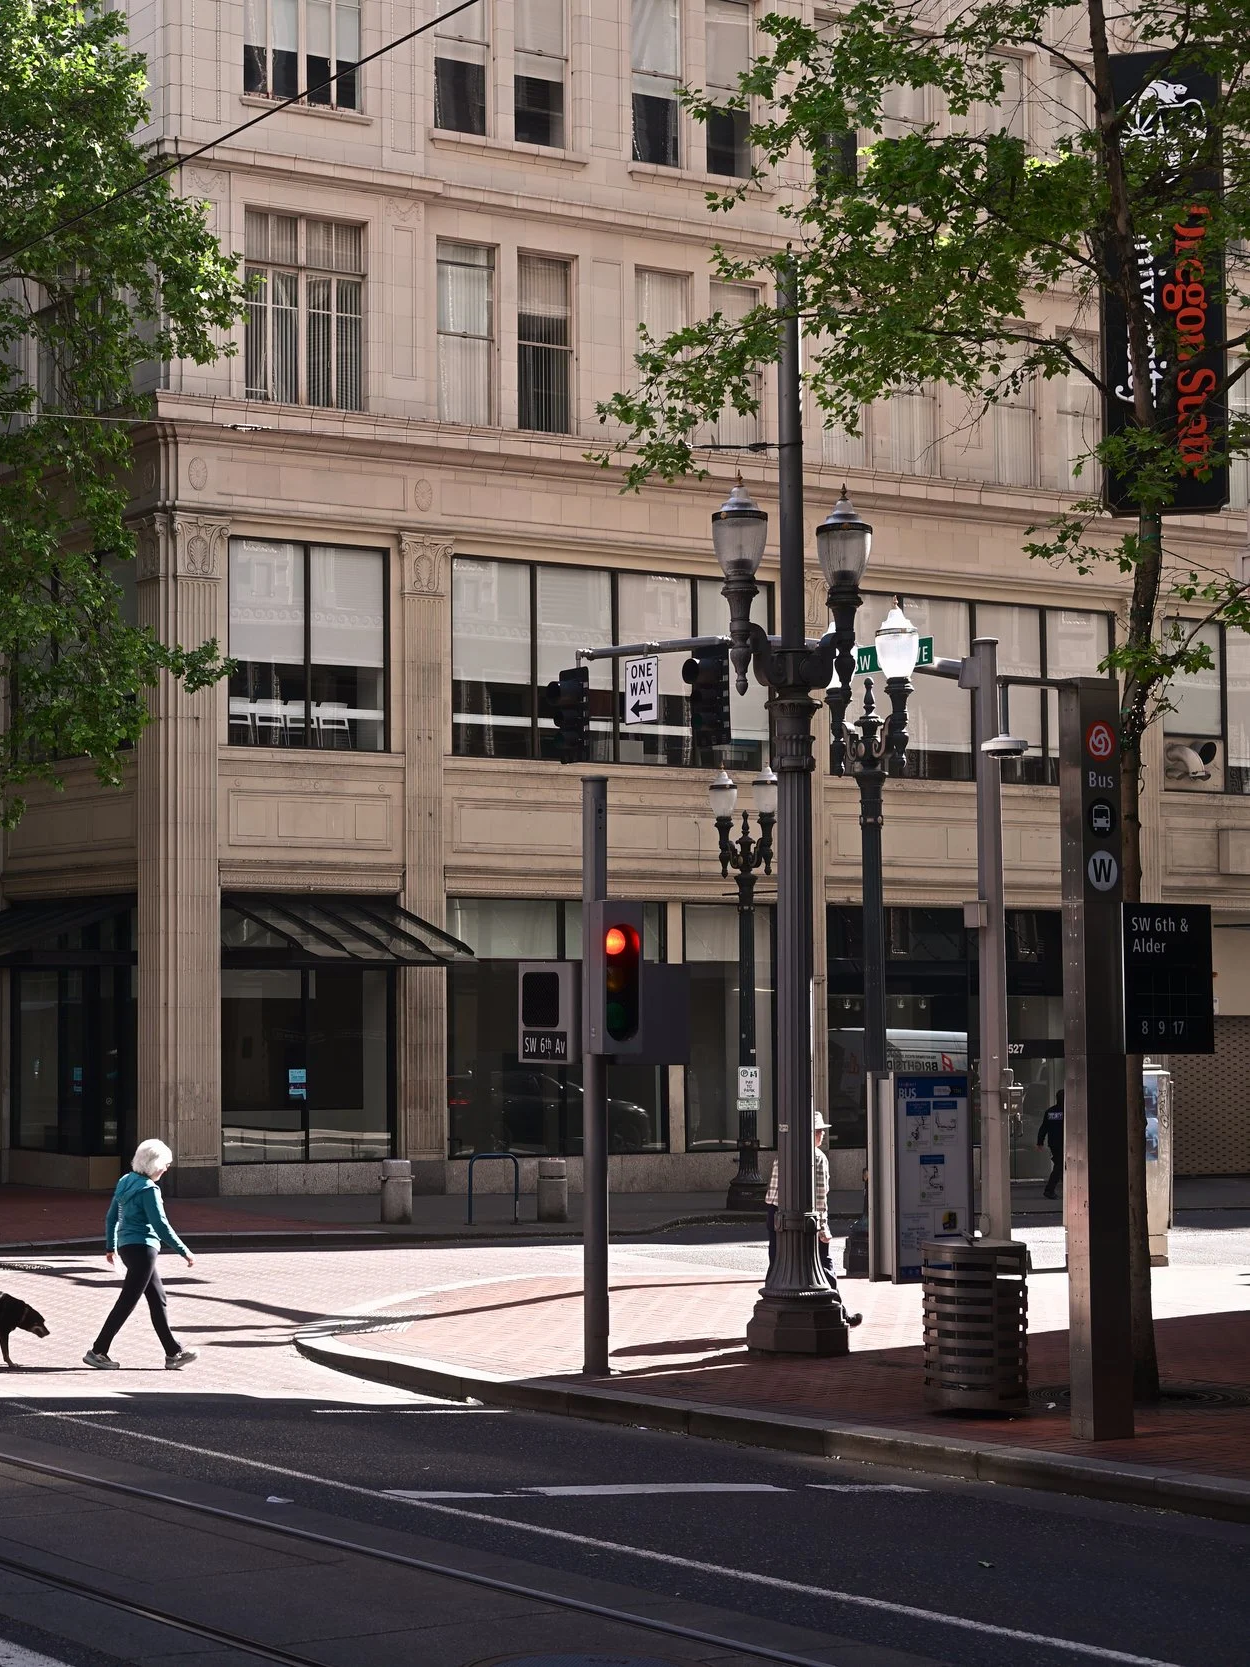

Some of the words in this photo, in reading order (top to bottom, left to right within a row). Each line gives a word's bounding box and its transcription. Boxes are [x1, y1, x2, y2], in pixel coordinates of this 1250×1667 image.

[631, 662, 652, 679] ONE
[630, 679, 653, 696] WAY
[1088, 771, 1114, 788] Bus
[1092, 858, 1113, 882] W
[1131, 917, 1151, 932] SW
[1154, 917, 1176, 932] 6th
[1180, 918, 1189, 932] &
[1132, 938, 1167, 953] Alder
[1141, 1020, 1149, 1035] 8
[1158, 1020, 1165, 1035] 9
[1173, 1020, 1184, 1035] 17
[524, 1037, 537, 1053] SW
[540, 1037, 552, 1053] 6th
[554, 1038, 566, 1054] Av
[1008, 1044, 1024, 1054] 527
[898, 1087, 917, 1099] BUS
